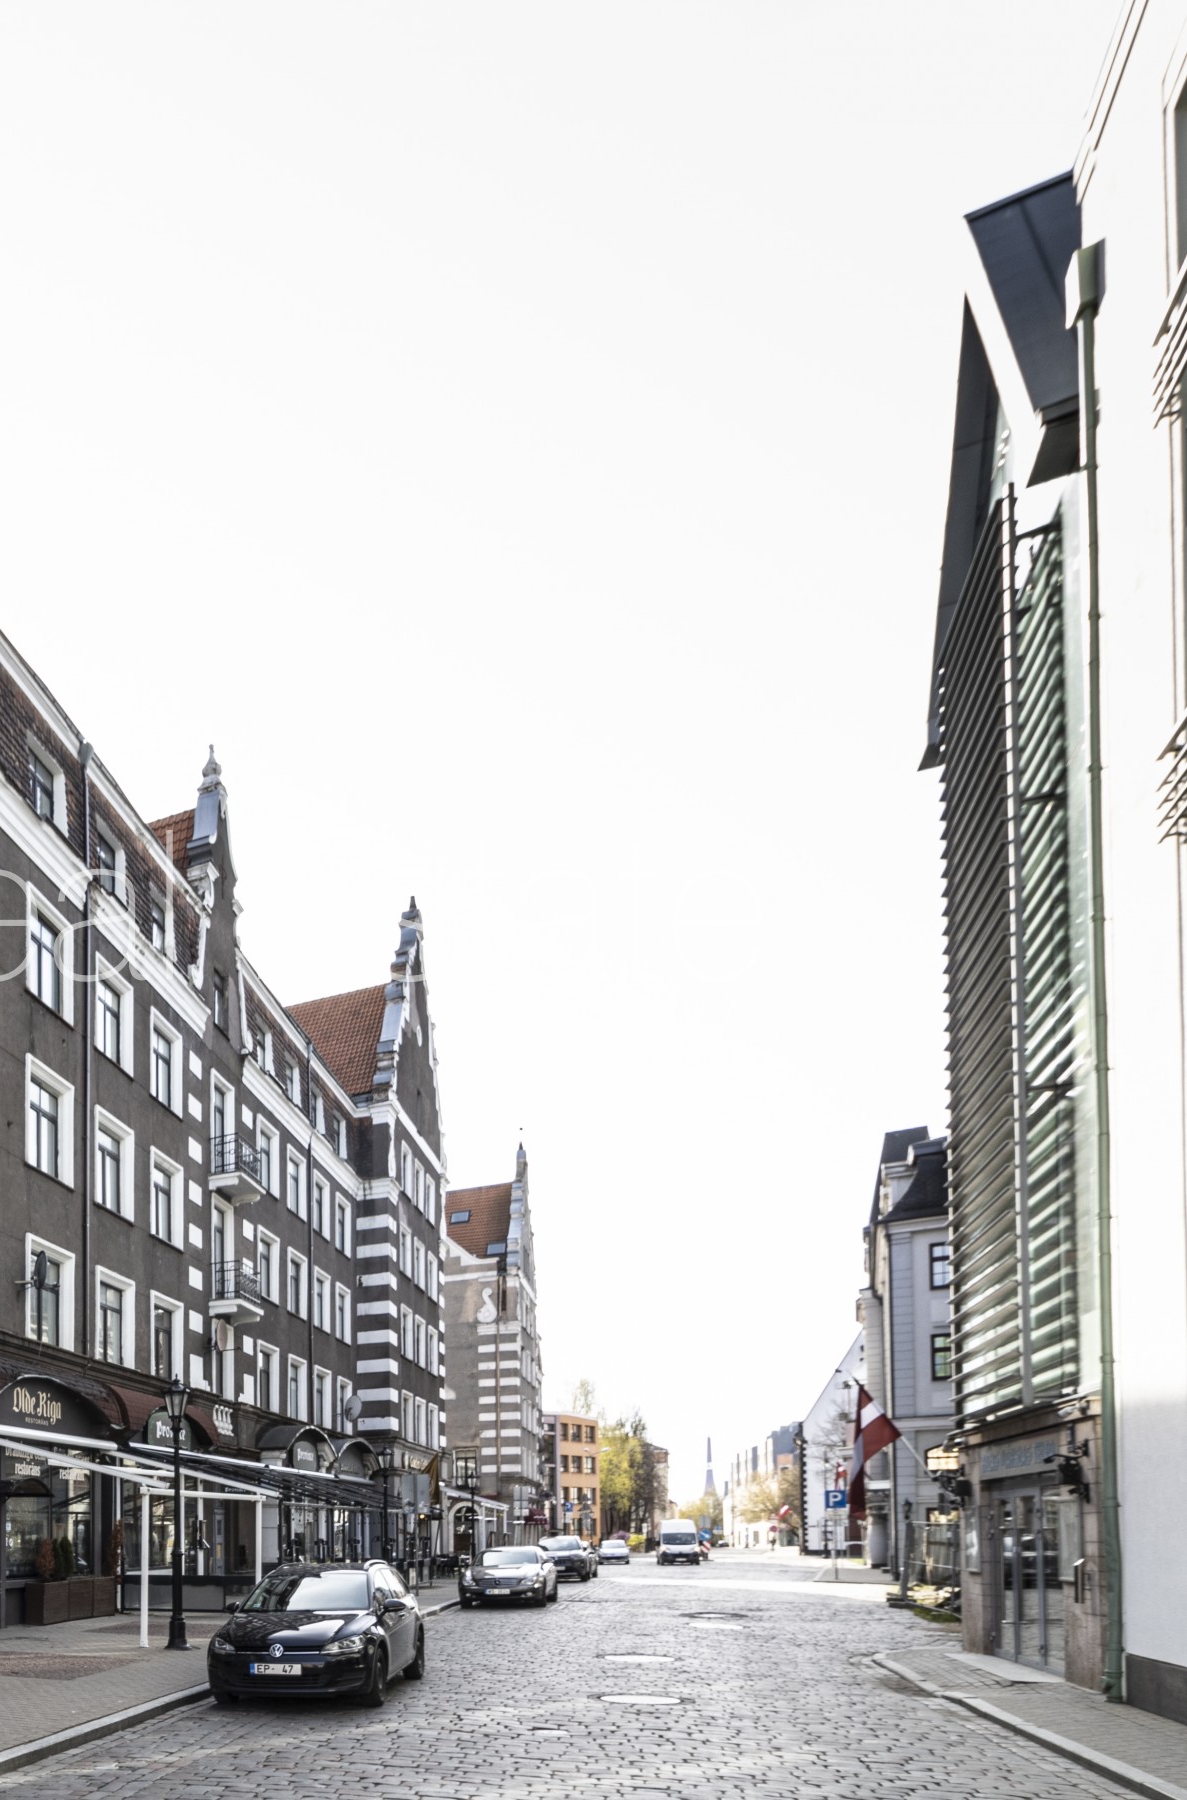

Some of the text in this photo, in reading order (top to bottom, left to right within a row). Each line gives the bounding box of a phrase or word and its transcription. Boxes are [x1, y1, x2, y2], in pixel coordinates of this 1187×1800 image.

[12, 1386, 62, 1426] Olde Riga
[828, 1492, 842, 1507] P
